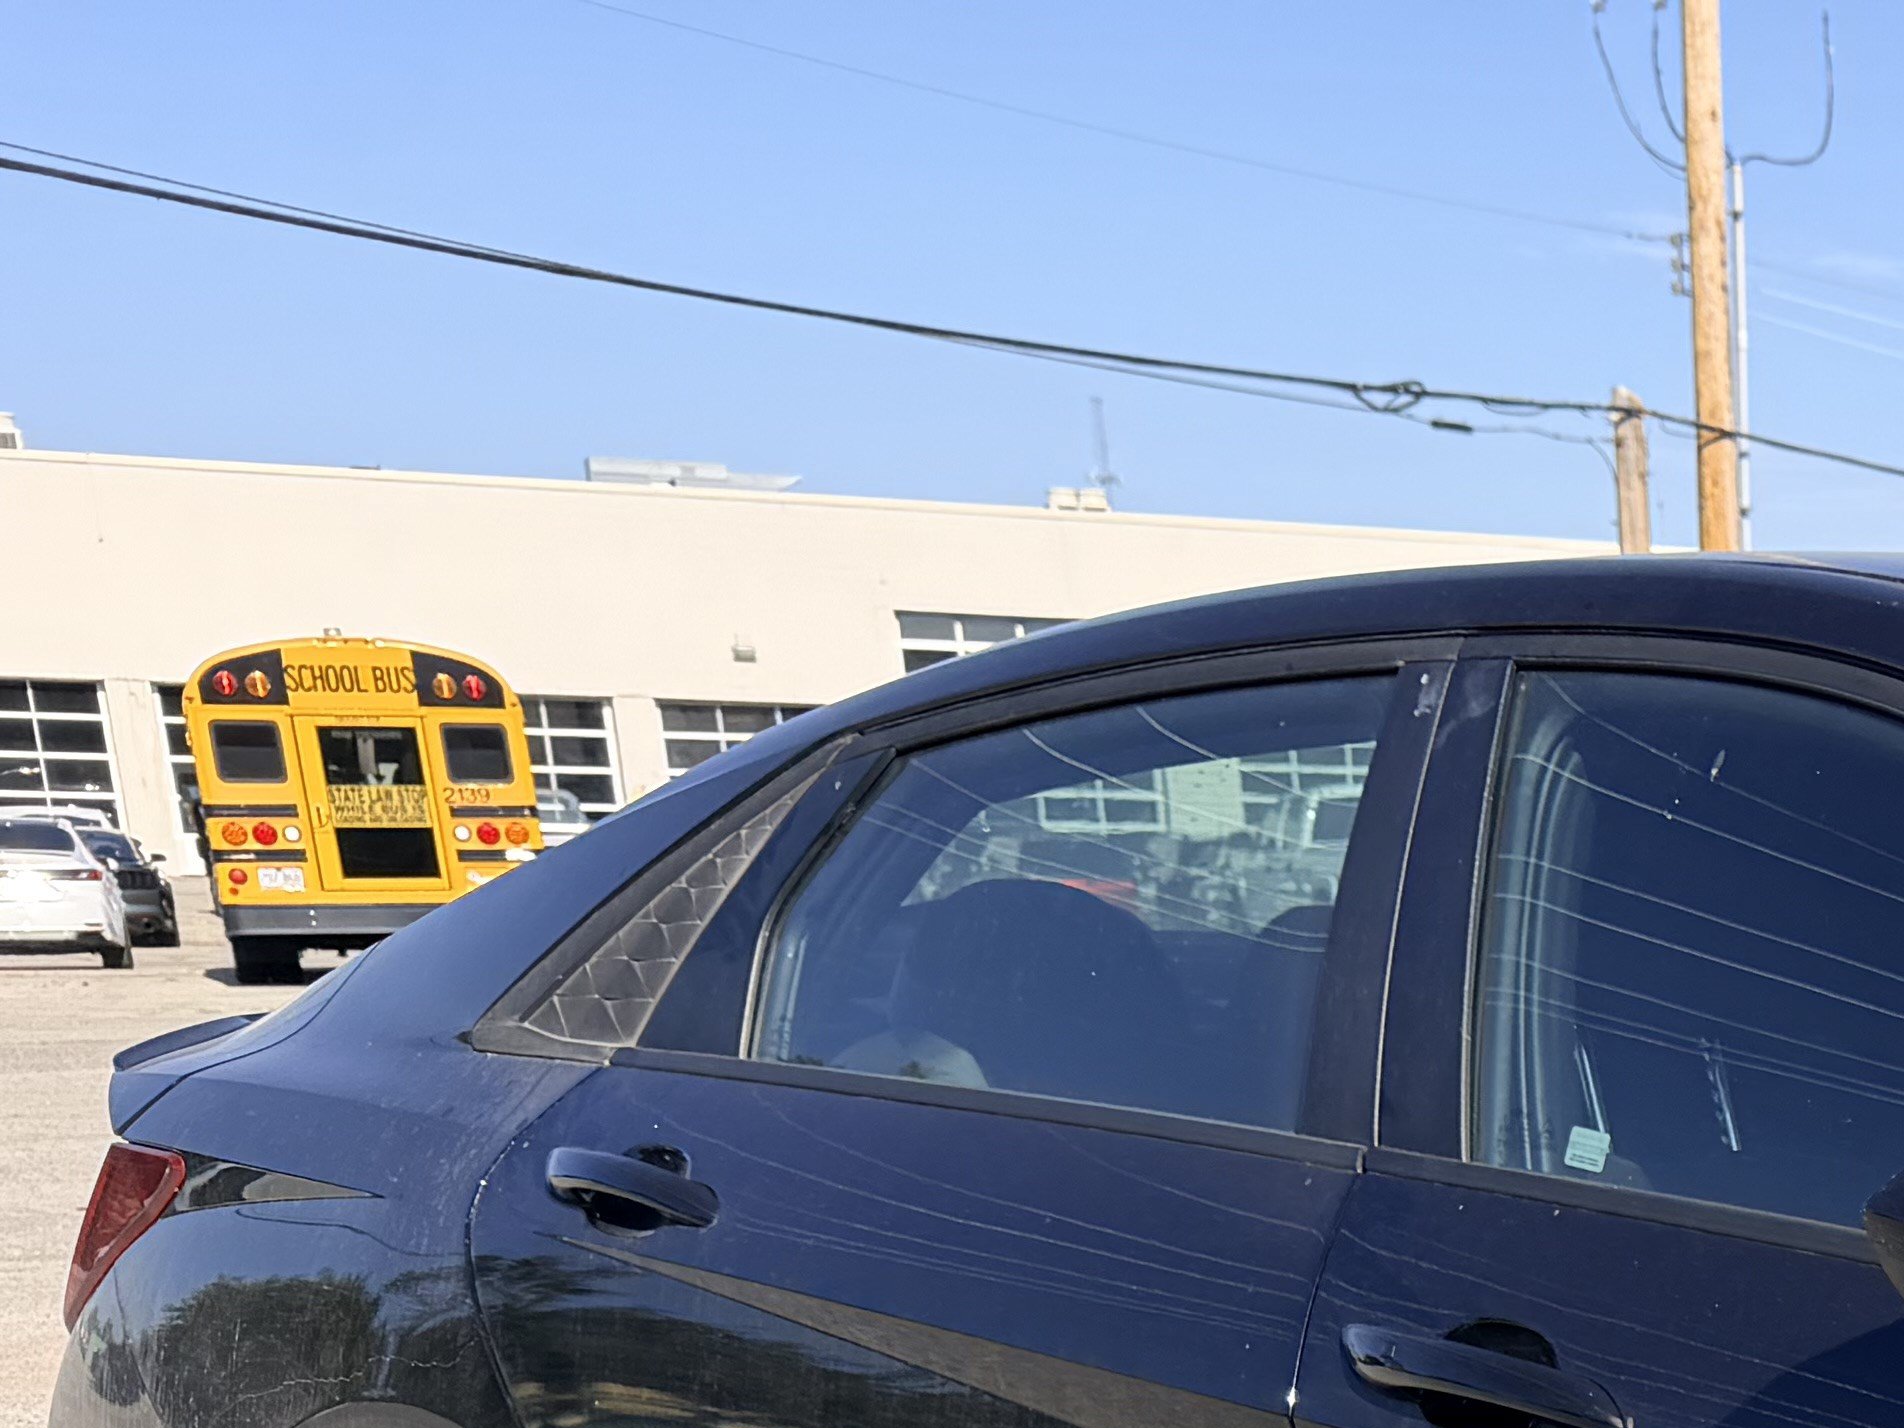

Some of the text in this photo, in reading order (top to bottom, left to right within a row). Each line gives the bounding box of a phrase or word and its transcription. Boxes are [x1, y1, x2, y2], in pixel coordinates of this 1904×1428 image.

[284, 664, 417, 694] SCHOOL BUS
[328, 787, 365, 803] STATE
[396, 787, 427, 804] STOP
